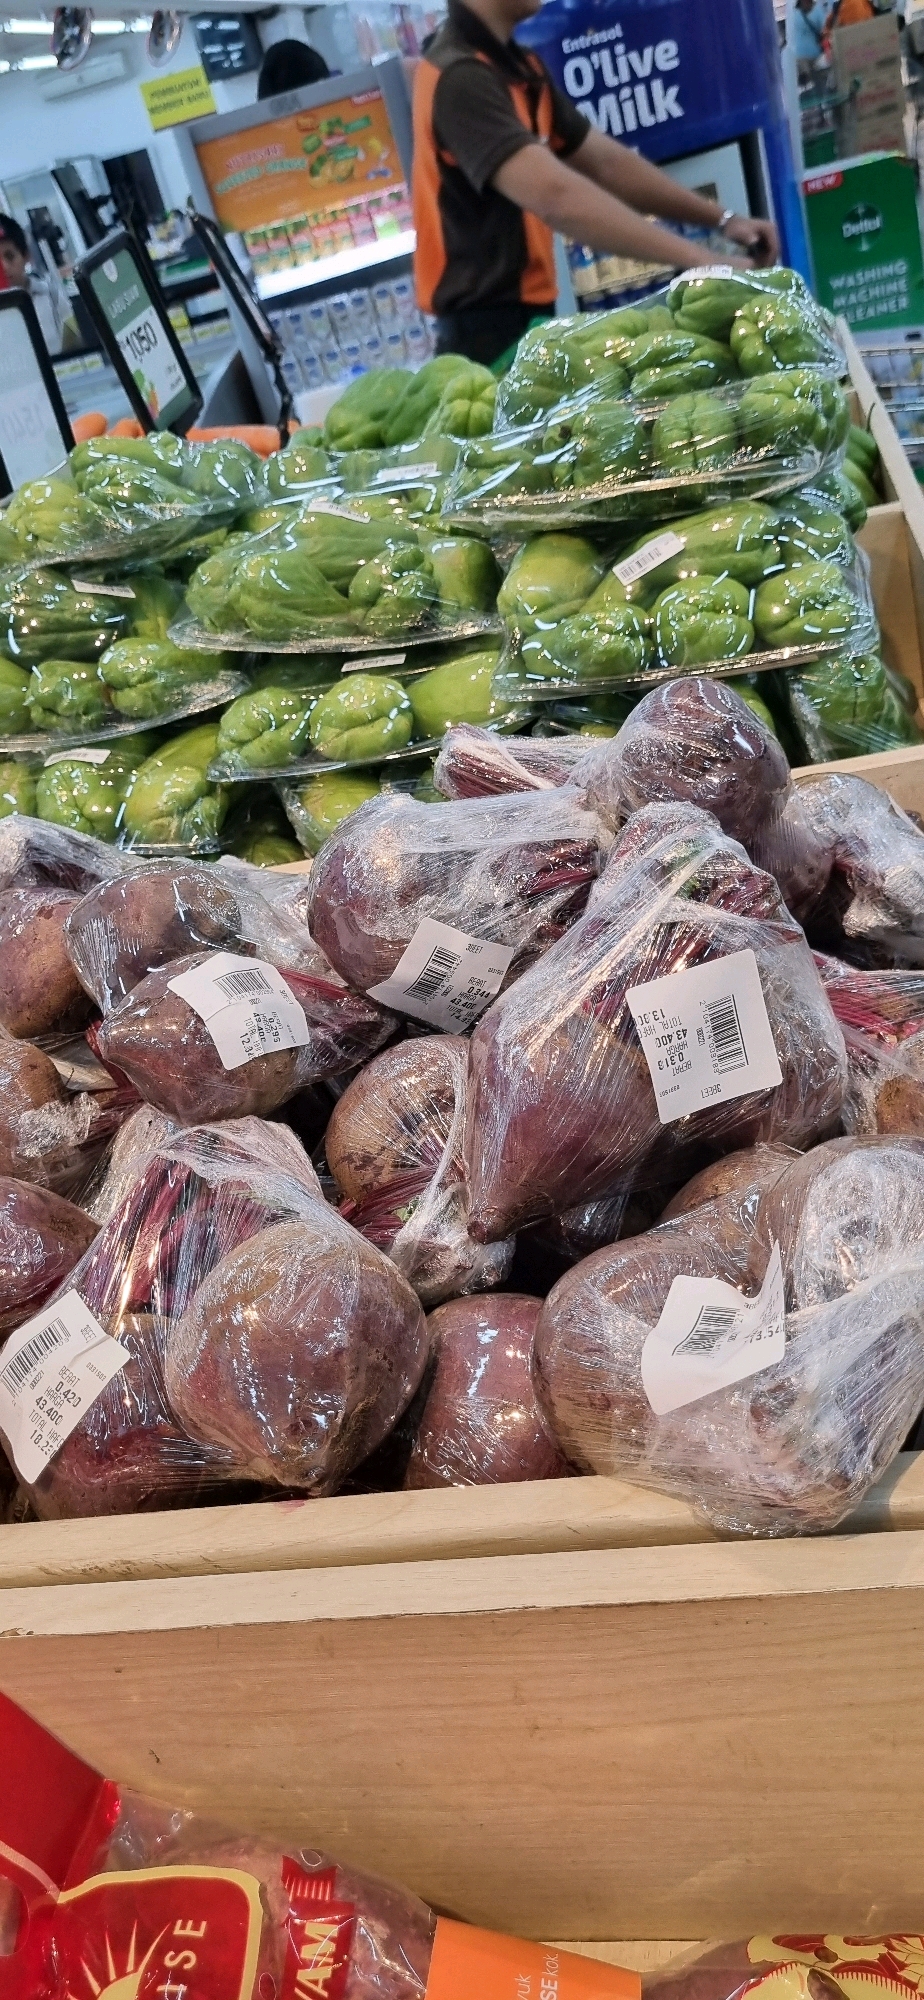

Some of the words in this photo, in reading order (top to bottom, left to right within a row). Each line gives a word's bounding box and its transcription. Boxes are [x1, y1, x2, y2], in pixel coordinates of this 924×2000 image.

[562, 22, 623, 54] Entrasol
[575, 78, 685, 136] Milk
[807, 174, 837, 192] NEW
[842, 216, 881, 238] Dettol
[829, 259, 907, 290] WASHING
[833, 278, 907, 309] MACHINE
[450, 997, 477, 1010] 43.400
[467, 986, 491, 999] 0.344
[659, 1016, 682, 1031] TOTAL
[672, 1060, 693, 1077] BERAT
[57, 1365, 80, 1386] BERAT
[44, 1386, 64, 1409] HARGA
[55, 1381, 82, 1407] 0.420
[29, 1409, 47, 1432] TOTAL
[35, 1396, 63, 1425] 43.400
